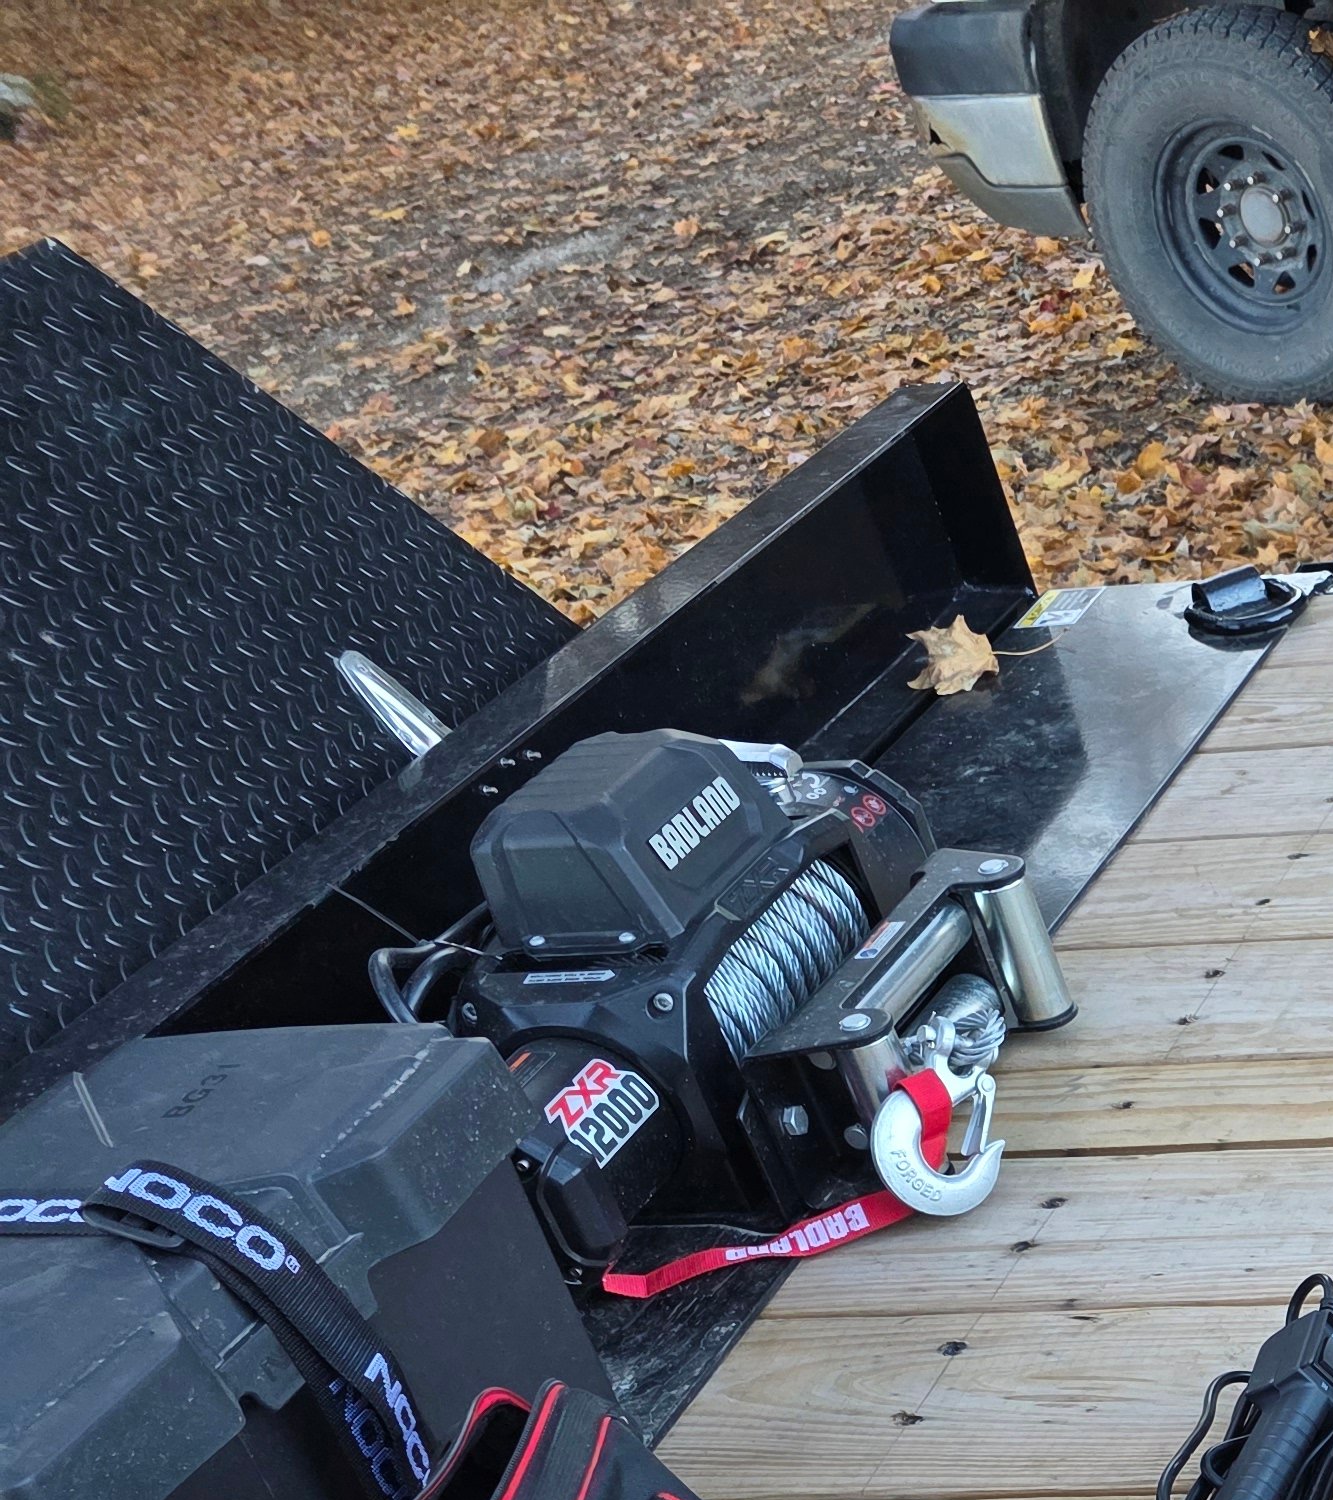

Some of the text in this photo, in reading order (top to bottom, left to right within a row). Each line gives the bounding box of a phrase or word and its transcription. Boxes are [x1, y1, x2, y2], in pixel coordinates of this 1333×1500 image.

[648, 775, 741, 871] BADLAND
[548, 1062, 621, 1129] ZXR
[569, 1074, 657, 1165] 12000
[889, 1149, 944, 1203] FORGED
[364, 1352, 431, 1489] NOC
